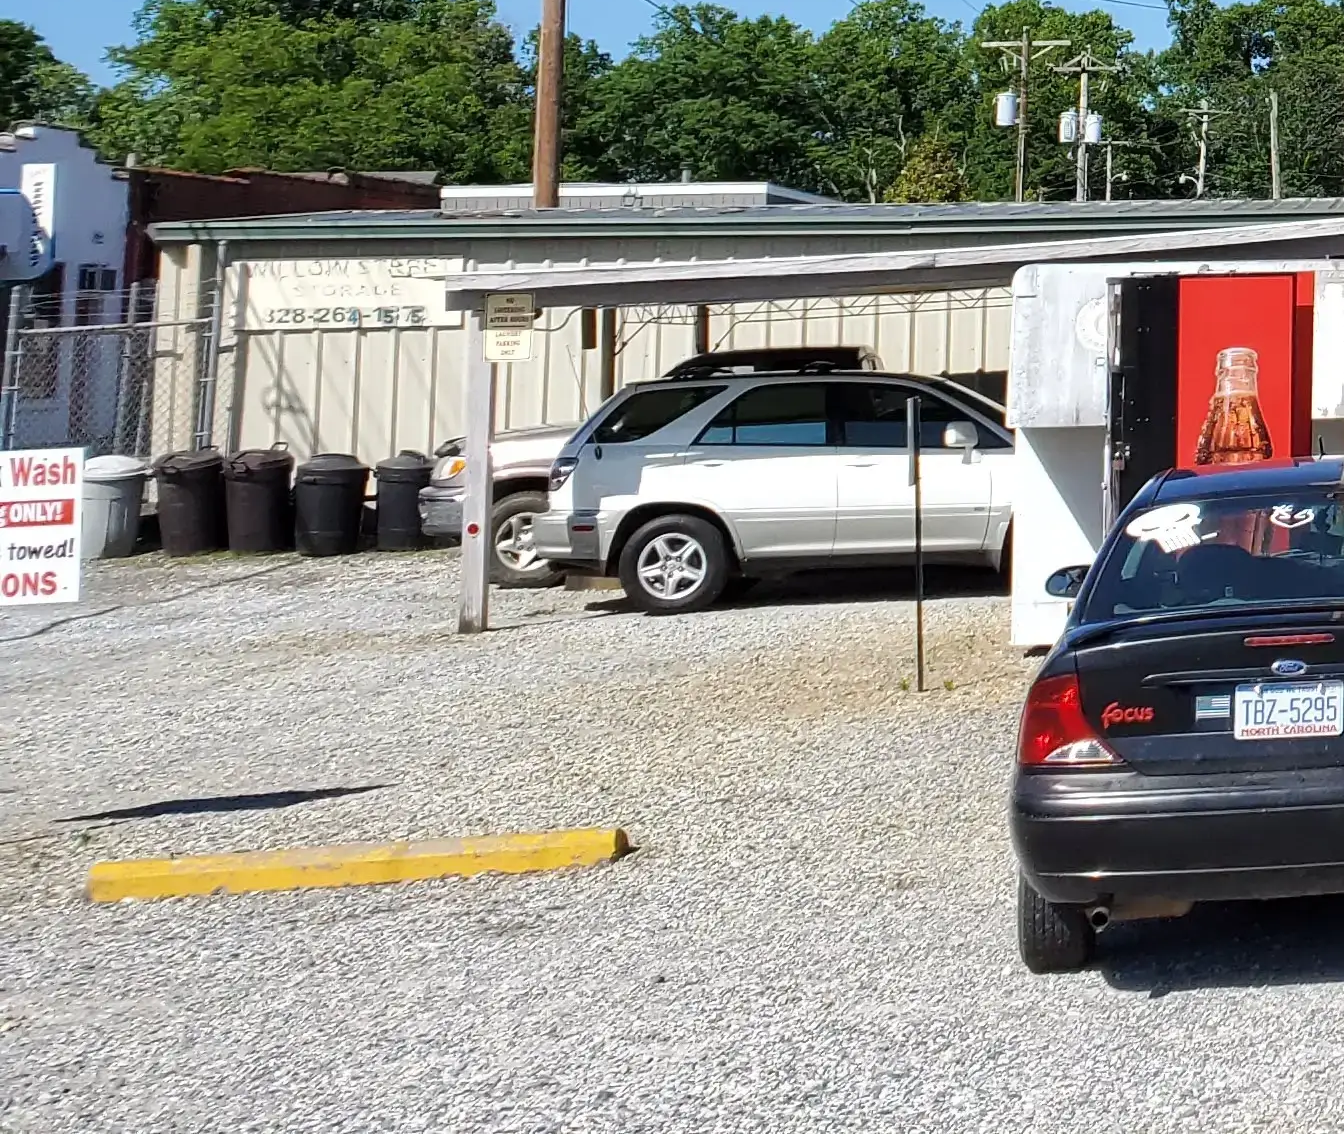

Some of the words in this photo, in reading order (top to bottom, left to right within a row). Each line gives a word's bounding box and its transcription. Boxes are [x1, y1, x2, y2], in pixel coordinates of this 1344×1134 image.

[359, 257, 453, 276] STREE
[10, 455, 76, 487] Wash
[9, 502, 65, 523] ONLY!
[8, 538, 75, 561] towed!
[1279, 662, 1300, 672] Ford
[1242, 695, 1338, 725] TBZ-5295
[1240, 726, 1280, 737] NORTH
[1283, 724, 1338, 735] CAROLINA
